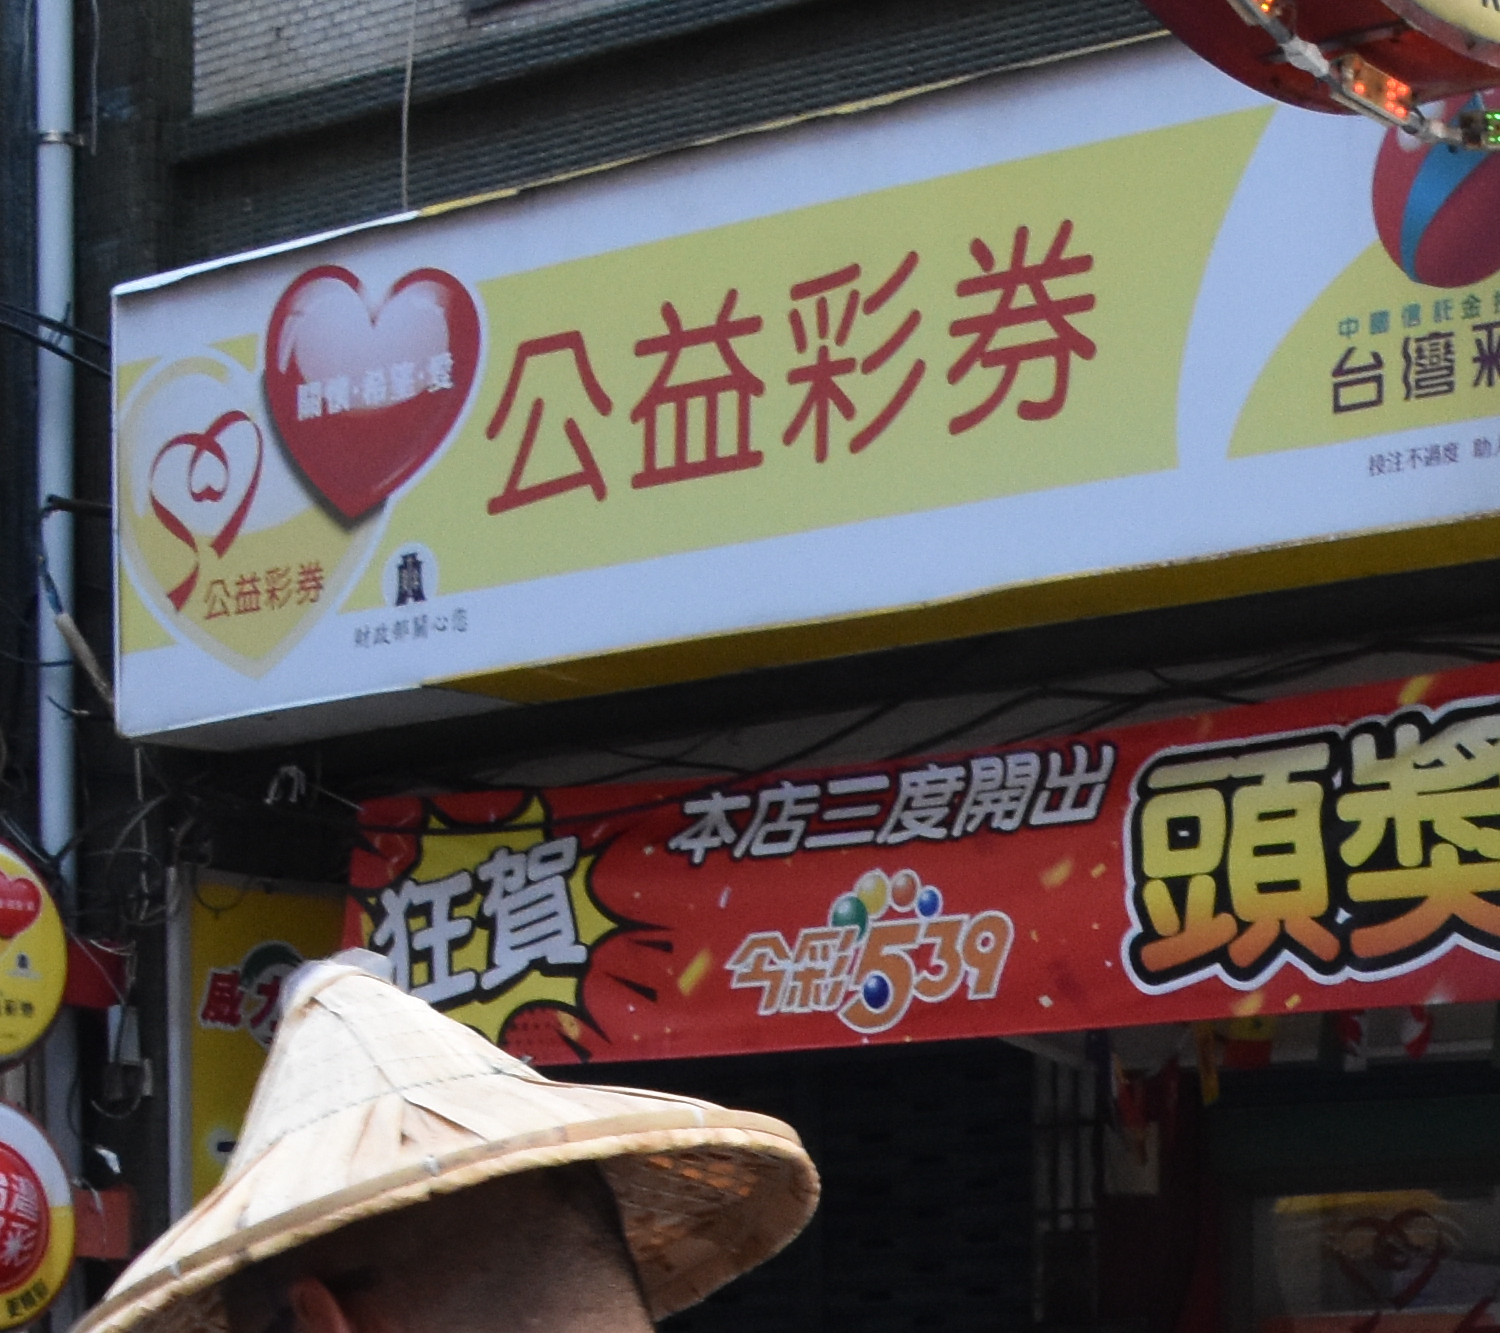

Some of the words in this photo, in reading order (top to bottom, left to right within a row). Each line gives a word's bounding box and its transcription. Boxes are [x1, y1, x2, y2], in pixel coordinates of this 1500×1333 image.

[486, 219, 1098, 516] 公益彩券
[203, 561, 325, 620] 公益彩券
[669, 743, 1114, 864] 本店三度開出
[372, 834, 589, 1006] 狂賀
[724, 909, 1016, 1035] 今彩539
